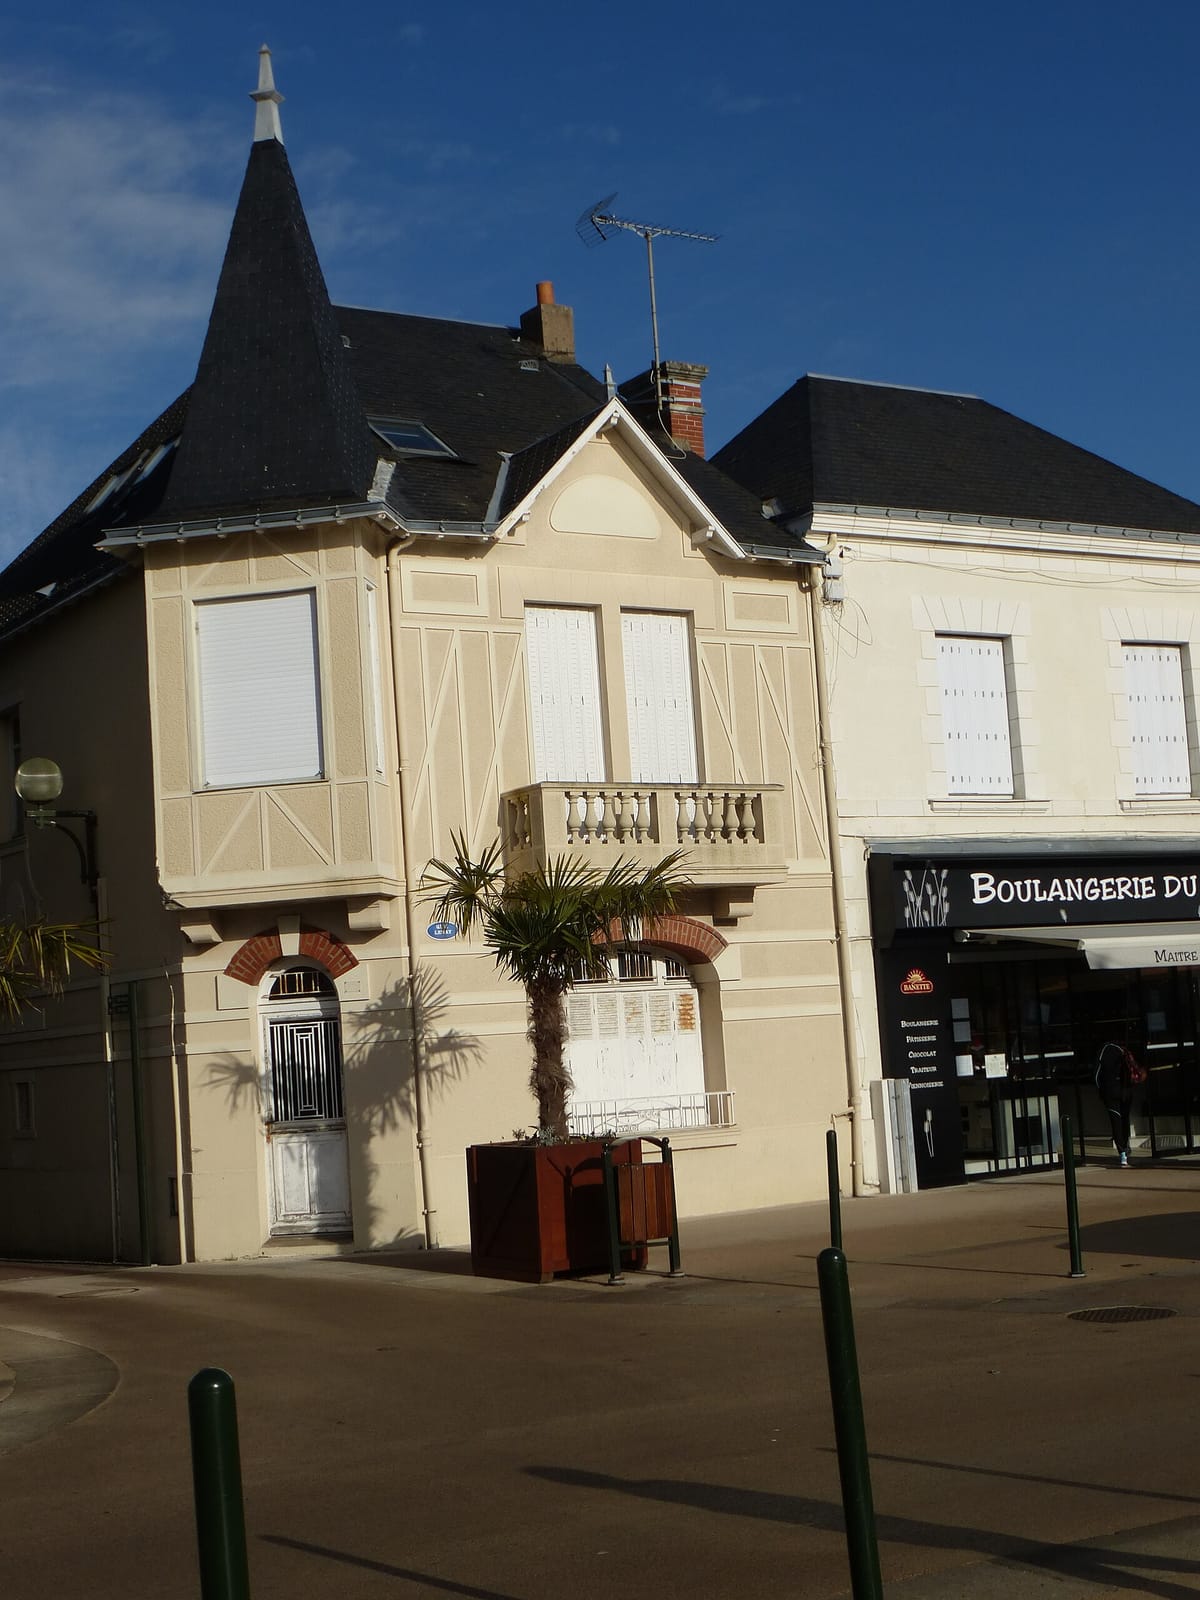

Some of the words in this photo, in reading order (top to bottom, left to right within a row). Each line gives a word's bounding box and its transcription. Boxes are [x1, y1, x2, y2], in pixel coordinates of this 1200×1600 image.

[970, 872, 1156, 904] BOULANGERIE
[1163, 875, 1197, 898] DU
[1154, 949, 1198, 963] MAITRE
[903, 983, 931, 992] BANETTE
[900, 1019, 939, 1028] BOULANGERIE
[908, 1050, 937, 1058] CHOCOLAT
[910, 1066, 937, 1074] TRAITEUR
